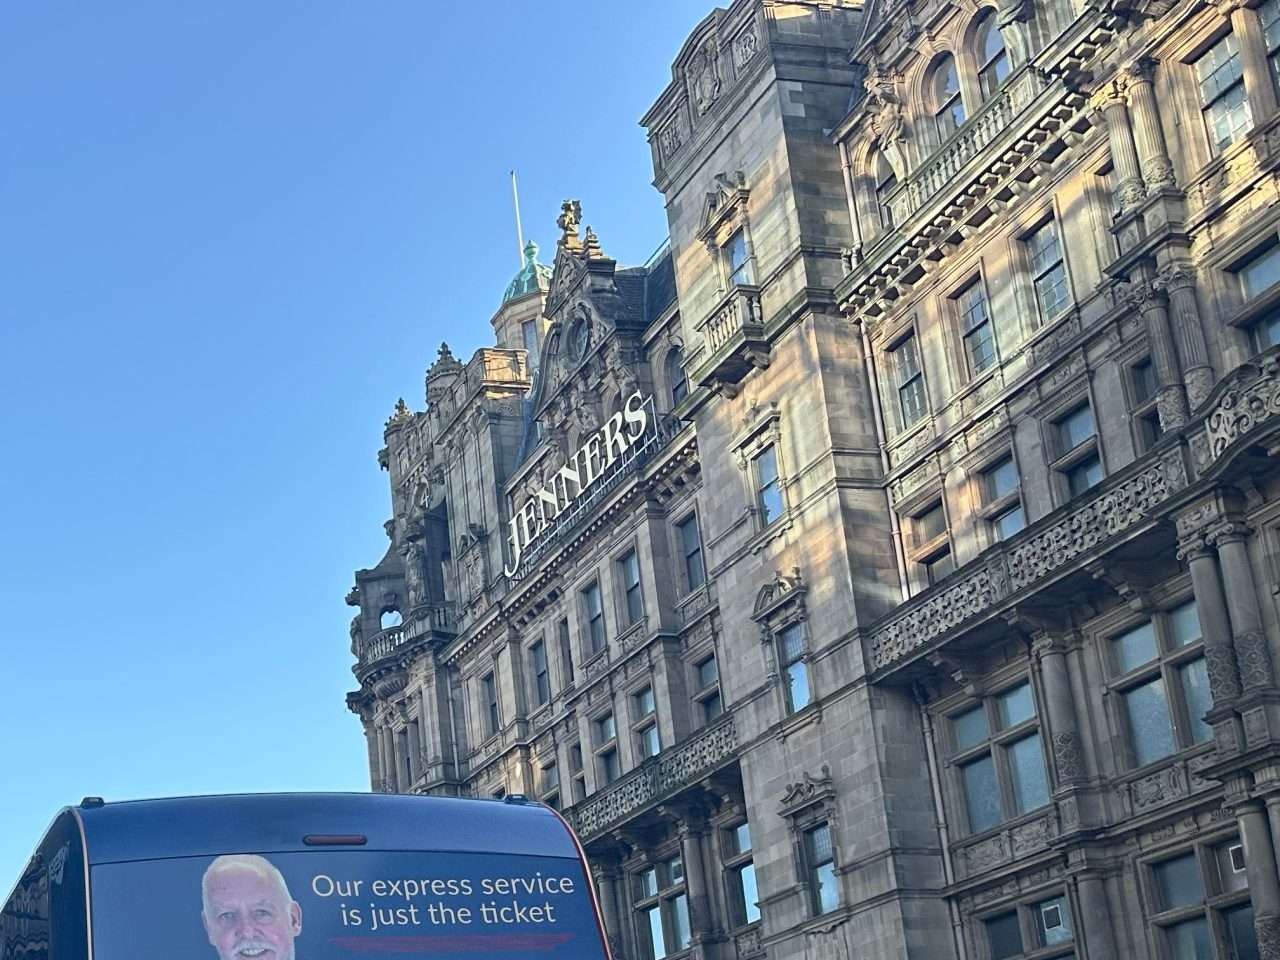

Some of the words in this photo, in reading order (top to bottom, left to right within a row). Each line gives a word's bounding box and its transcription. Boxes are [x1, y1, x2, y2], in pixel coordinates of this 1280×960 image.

[504, 389, 648, 577] JENNERS
[312, 874, 363, 897] Our
[372, 877, 473, 901] express
[482, 872, 575, 895] service
[340, 903, 362, 926] is
[371, 902, 421, 931] just
[427, 902, 472, 924] the
[480, 900, 557, 924] ticket
